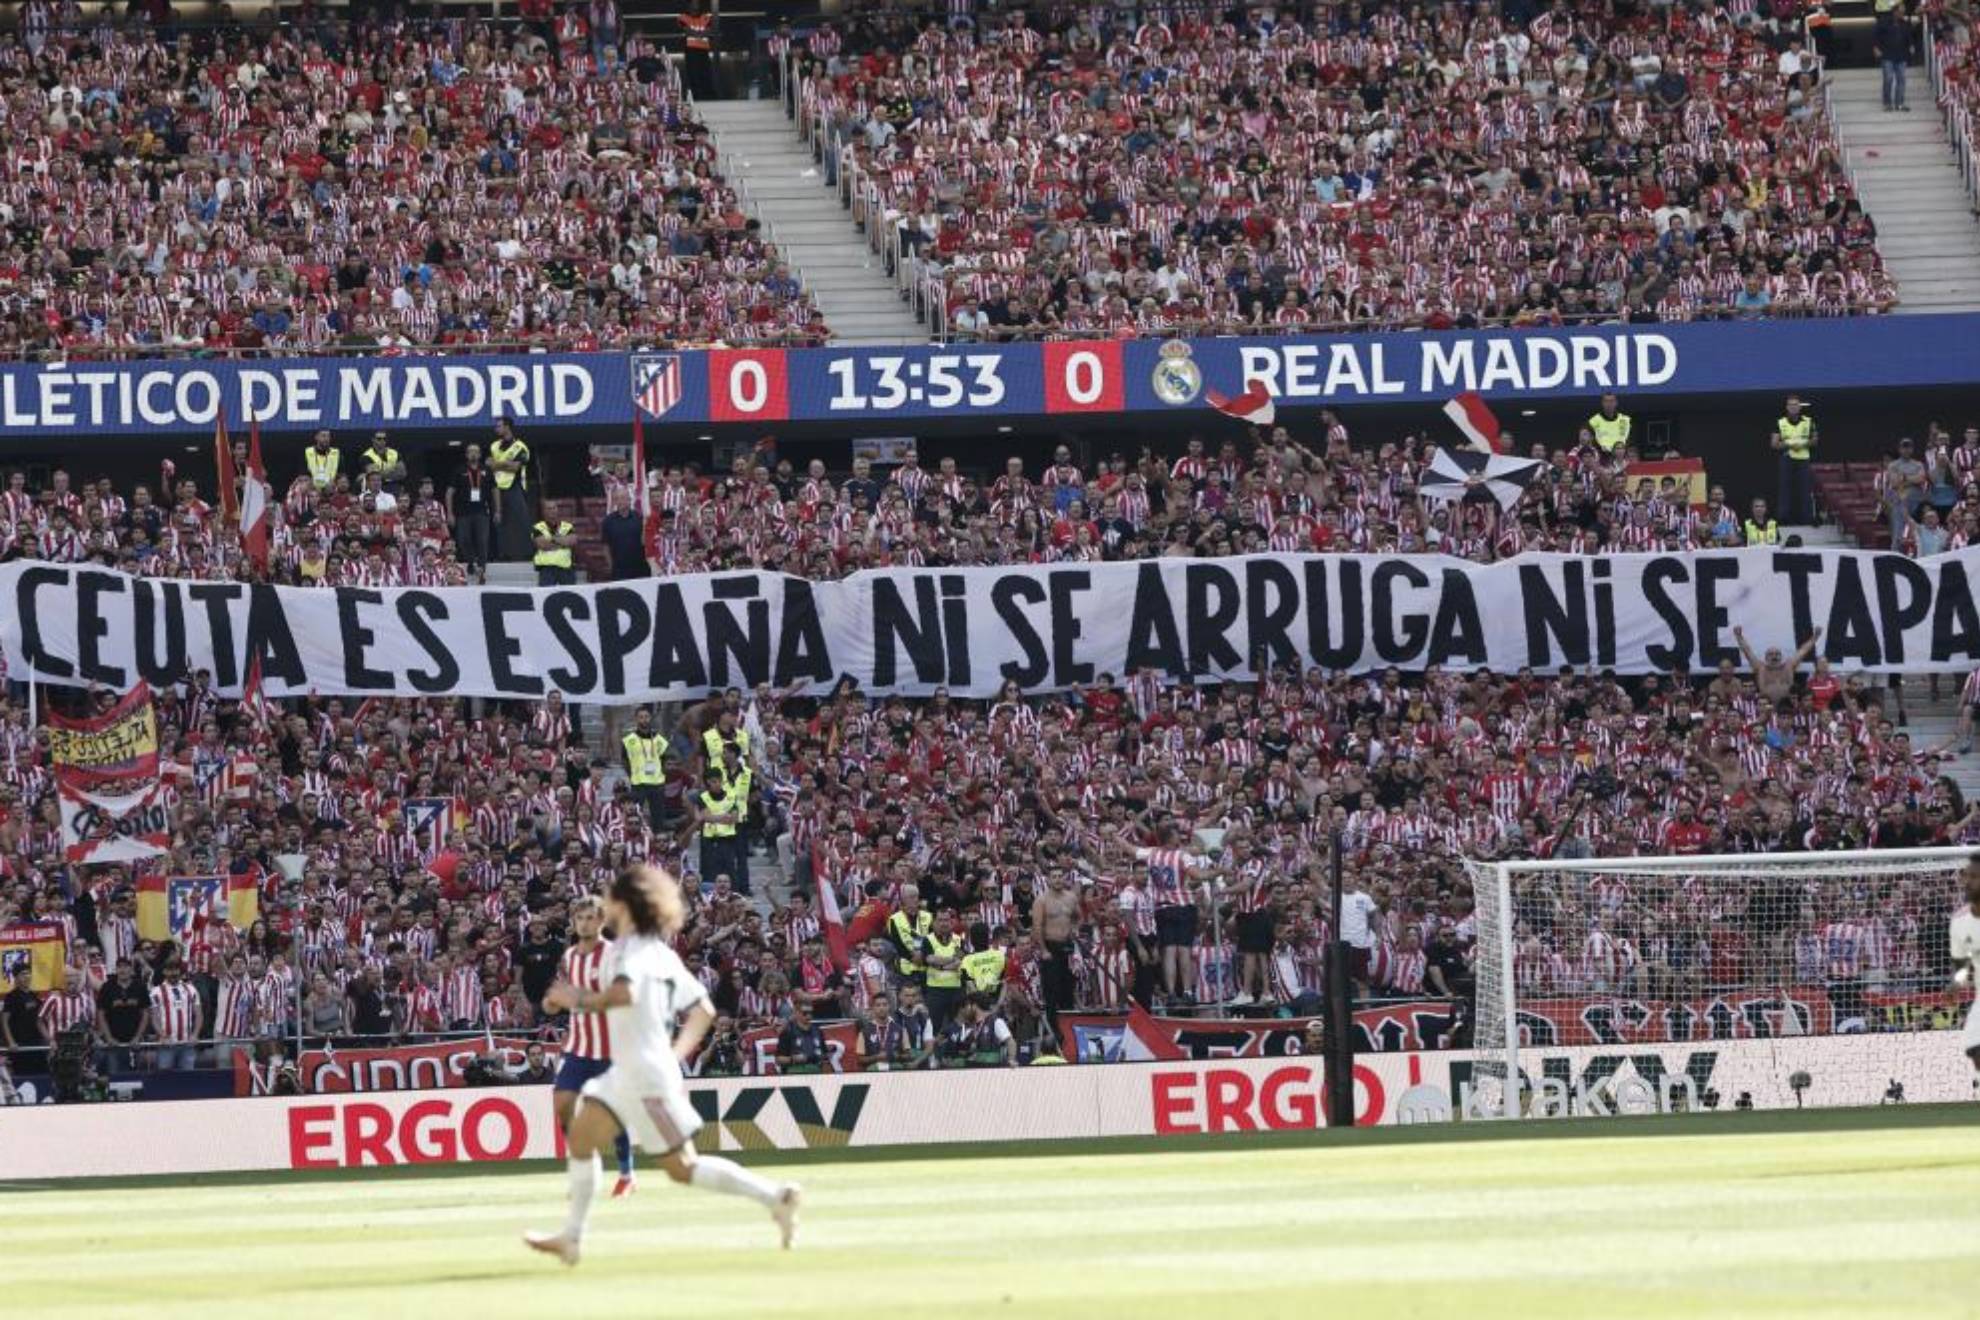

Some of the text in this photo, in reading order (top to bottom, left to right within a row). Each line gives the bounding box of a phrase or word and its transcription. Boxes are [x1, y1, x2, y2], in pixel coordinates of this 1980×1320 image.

[240, 369, 321, 421] DE
[338, 363, 594, 421] MADRID
[729, 360, 767, 412] 0
[828, 354, 1004, 410] 13:53
[1065, 352, 1103, 404] 0
[1241, 334, 1677, 397] REAL MADRID
[16, 566, 308, 688] CEUTA
[336, 587, 459, 693] ES
[480, 575, 834, 694] ESPAÑA
[991, 570, 1094, 686] SE
[1124, 558, 1488, 677] ARRUGA
[1641, 556, 1738, 668] SE
[1772, 555, 1980, 666] TAPA
[690, 1084, 871, 1149] KV
[1152, 1065, 1385, 1134] ERGO
[288, 1097, 528, 1168] ERGO
